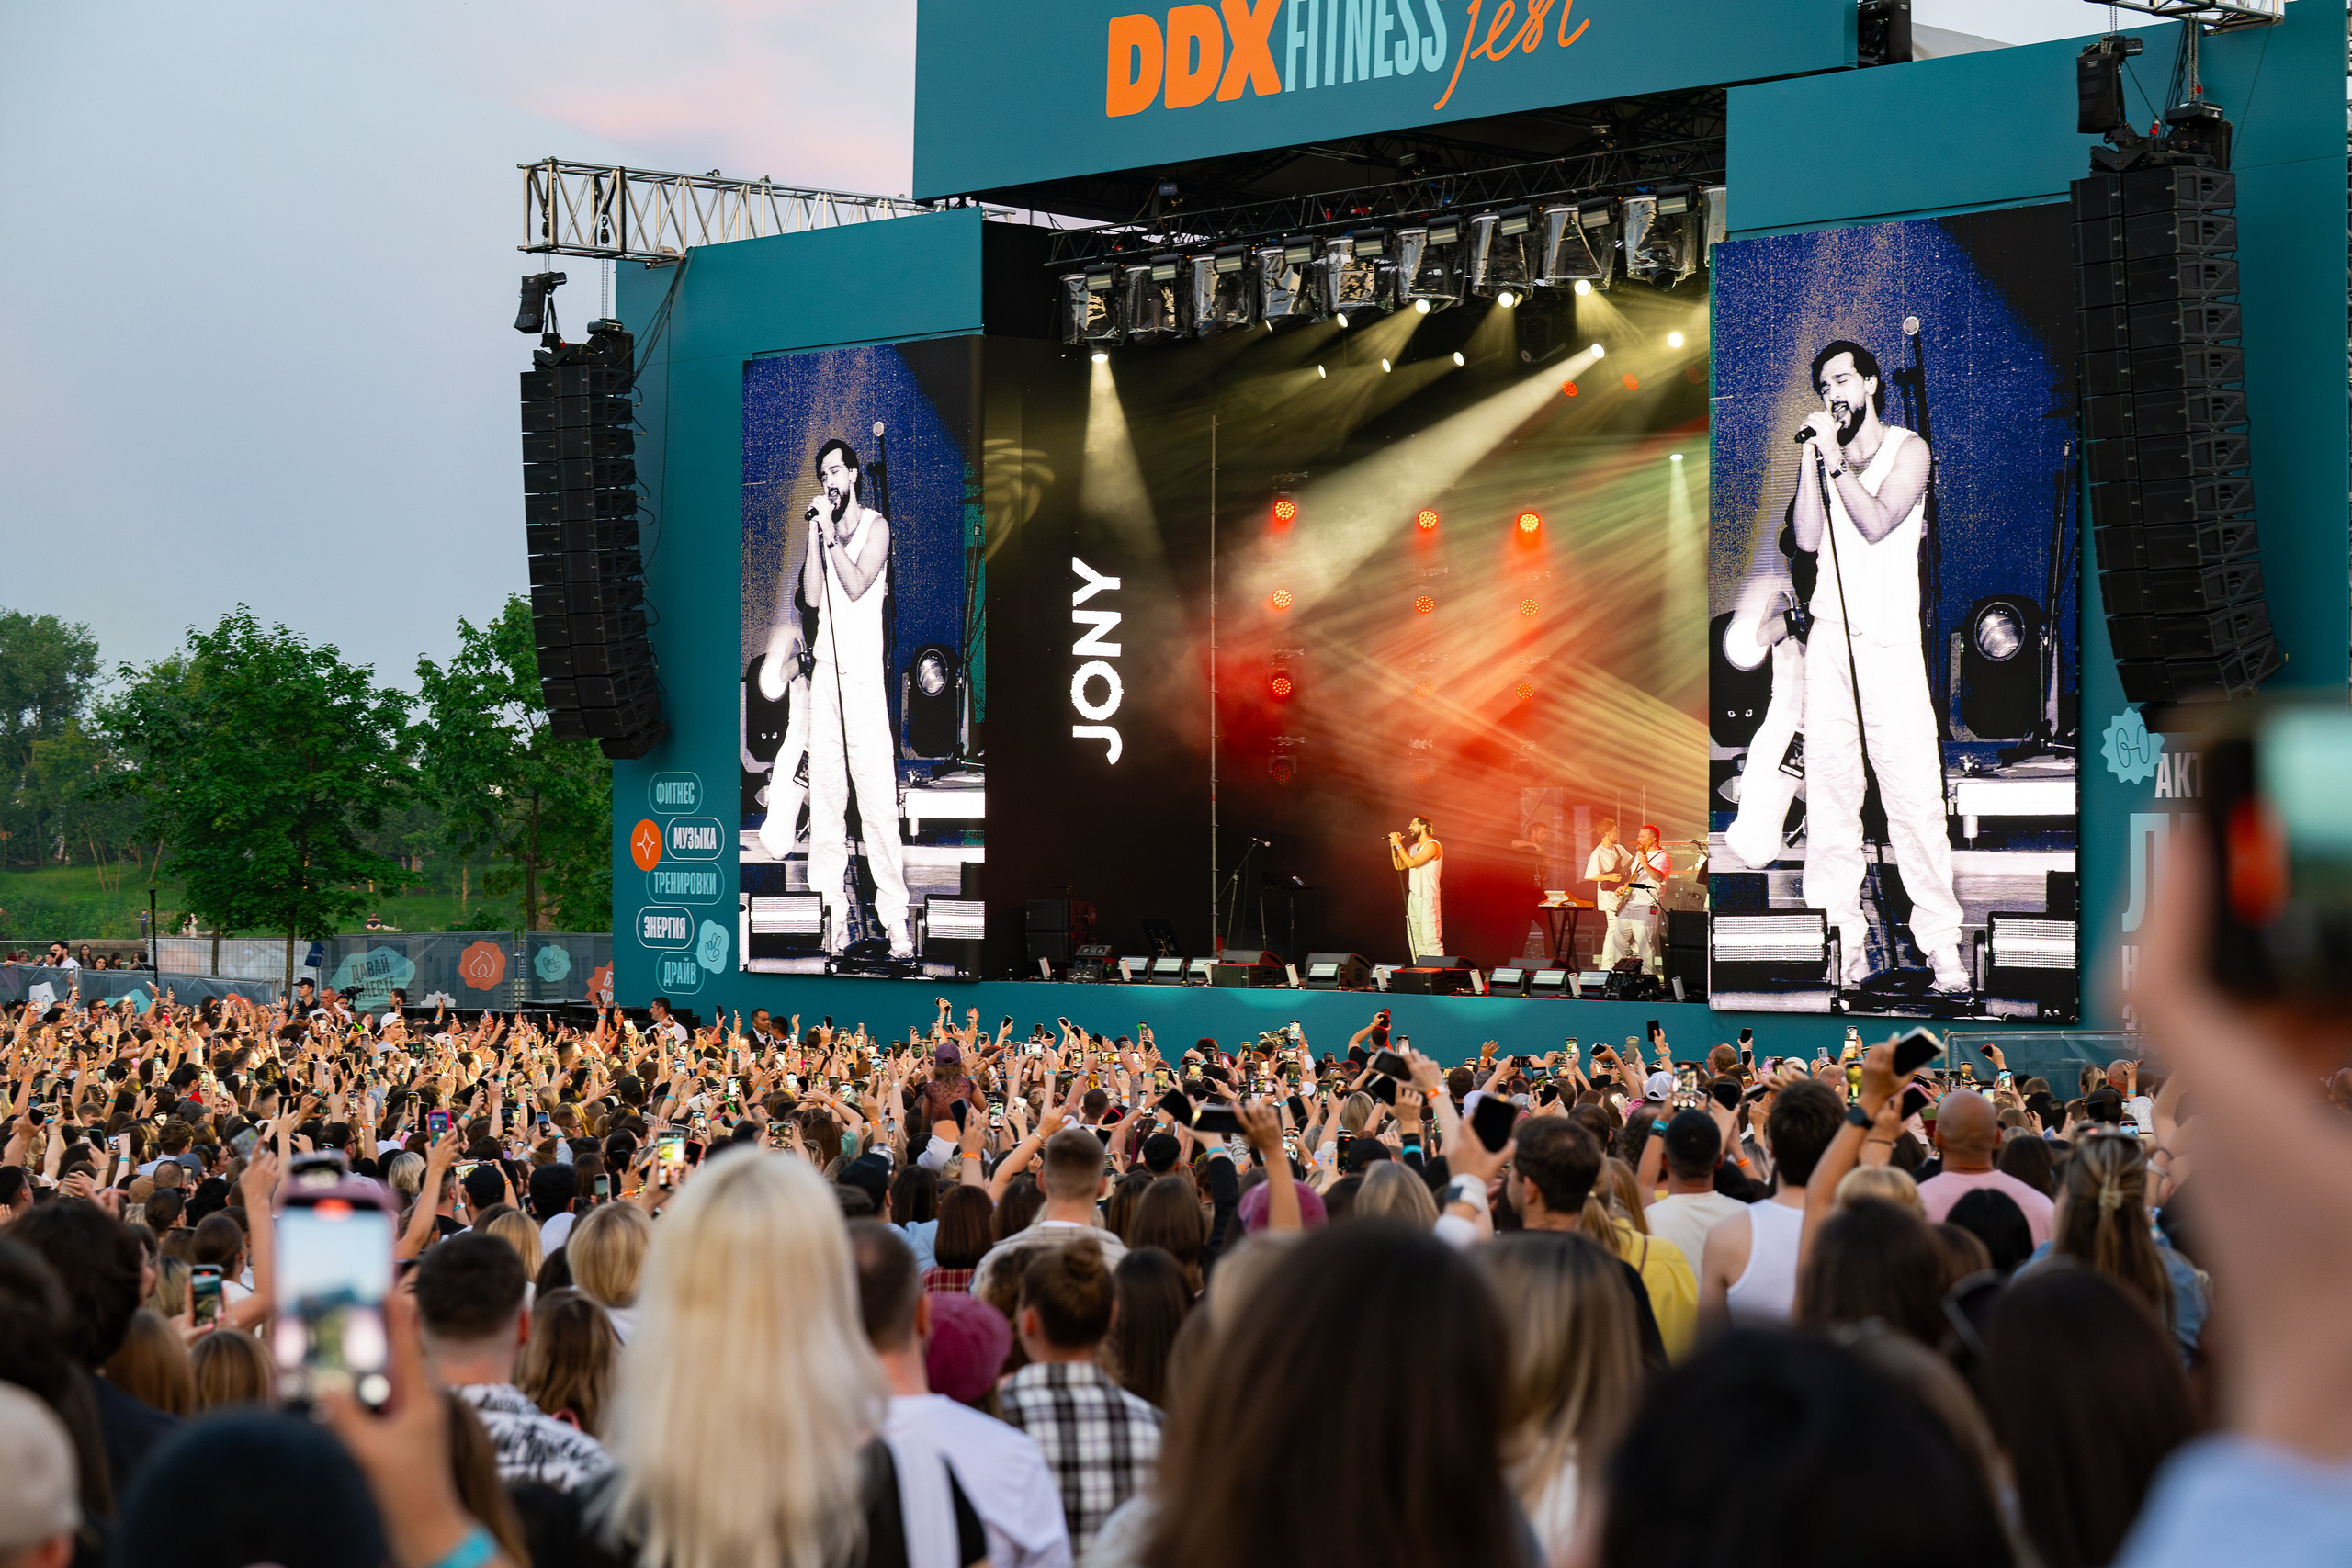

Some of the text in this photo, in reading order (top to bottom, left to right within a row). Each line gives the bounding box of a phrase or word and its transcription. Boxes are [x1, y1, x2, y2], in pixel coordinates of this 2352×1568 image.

[1106, 0, 1282, 118] DDX
[1285, 0, 1448, 92] FITNESS
[1070, 556, 1125, 765] JONY
[656, 781, 695, 805] ФИТНЕС
[673, 827, 717, 850] МУЗЫКА
[654, 872, 717, 895] ТРЕНИРОВКИ
[644, 916, 686, 939] ЭНЕРГИЯ
[351, 954, 390, 984] ДАВАЙ
[663, 957, 696, 987] ДРАЙВ
[356, 976, 395, 1002] МЕСТЕ
